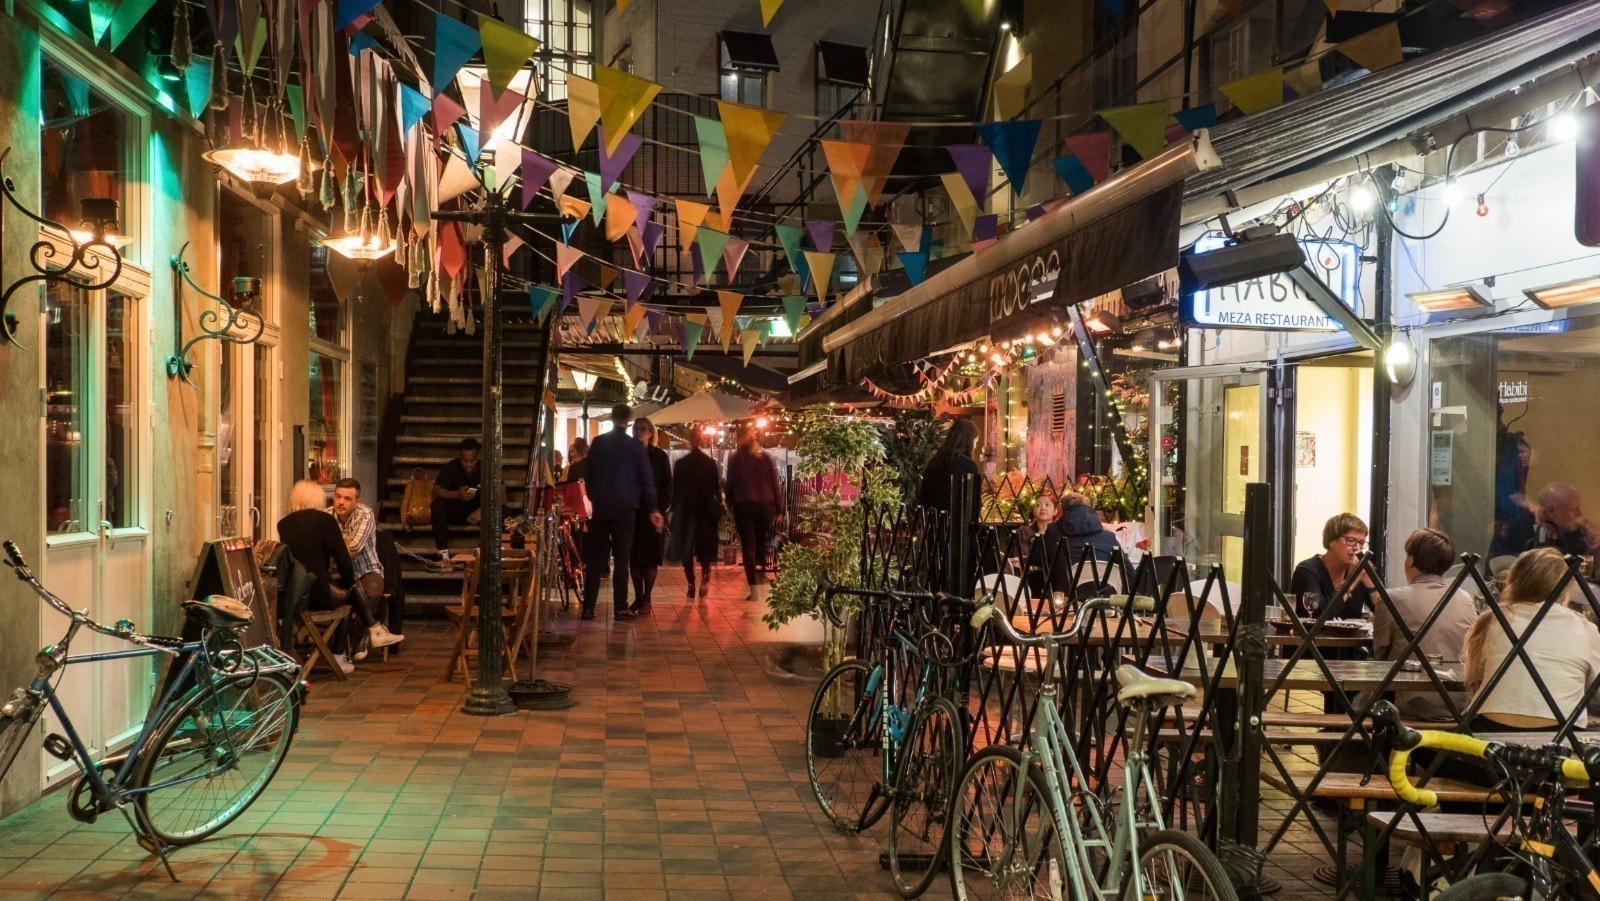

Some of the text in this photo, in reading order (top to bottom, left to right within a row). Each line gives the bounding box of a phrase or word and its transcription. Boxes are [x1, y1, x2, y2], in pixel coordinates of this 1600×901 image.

[1218, 312, 1331, 327] MEZA RESTAURANT
[1498, 381, 1528, 397] Habibi
